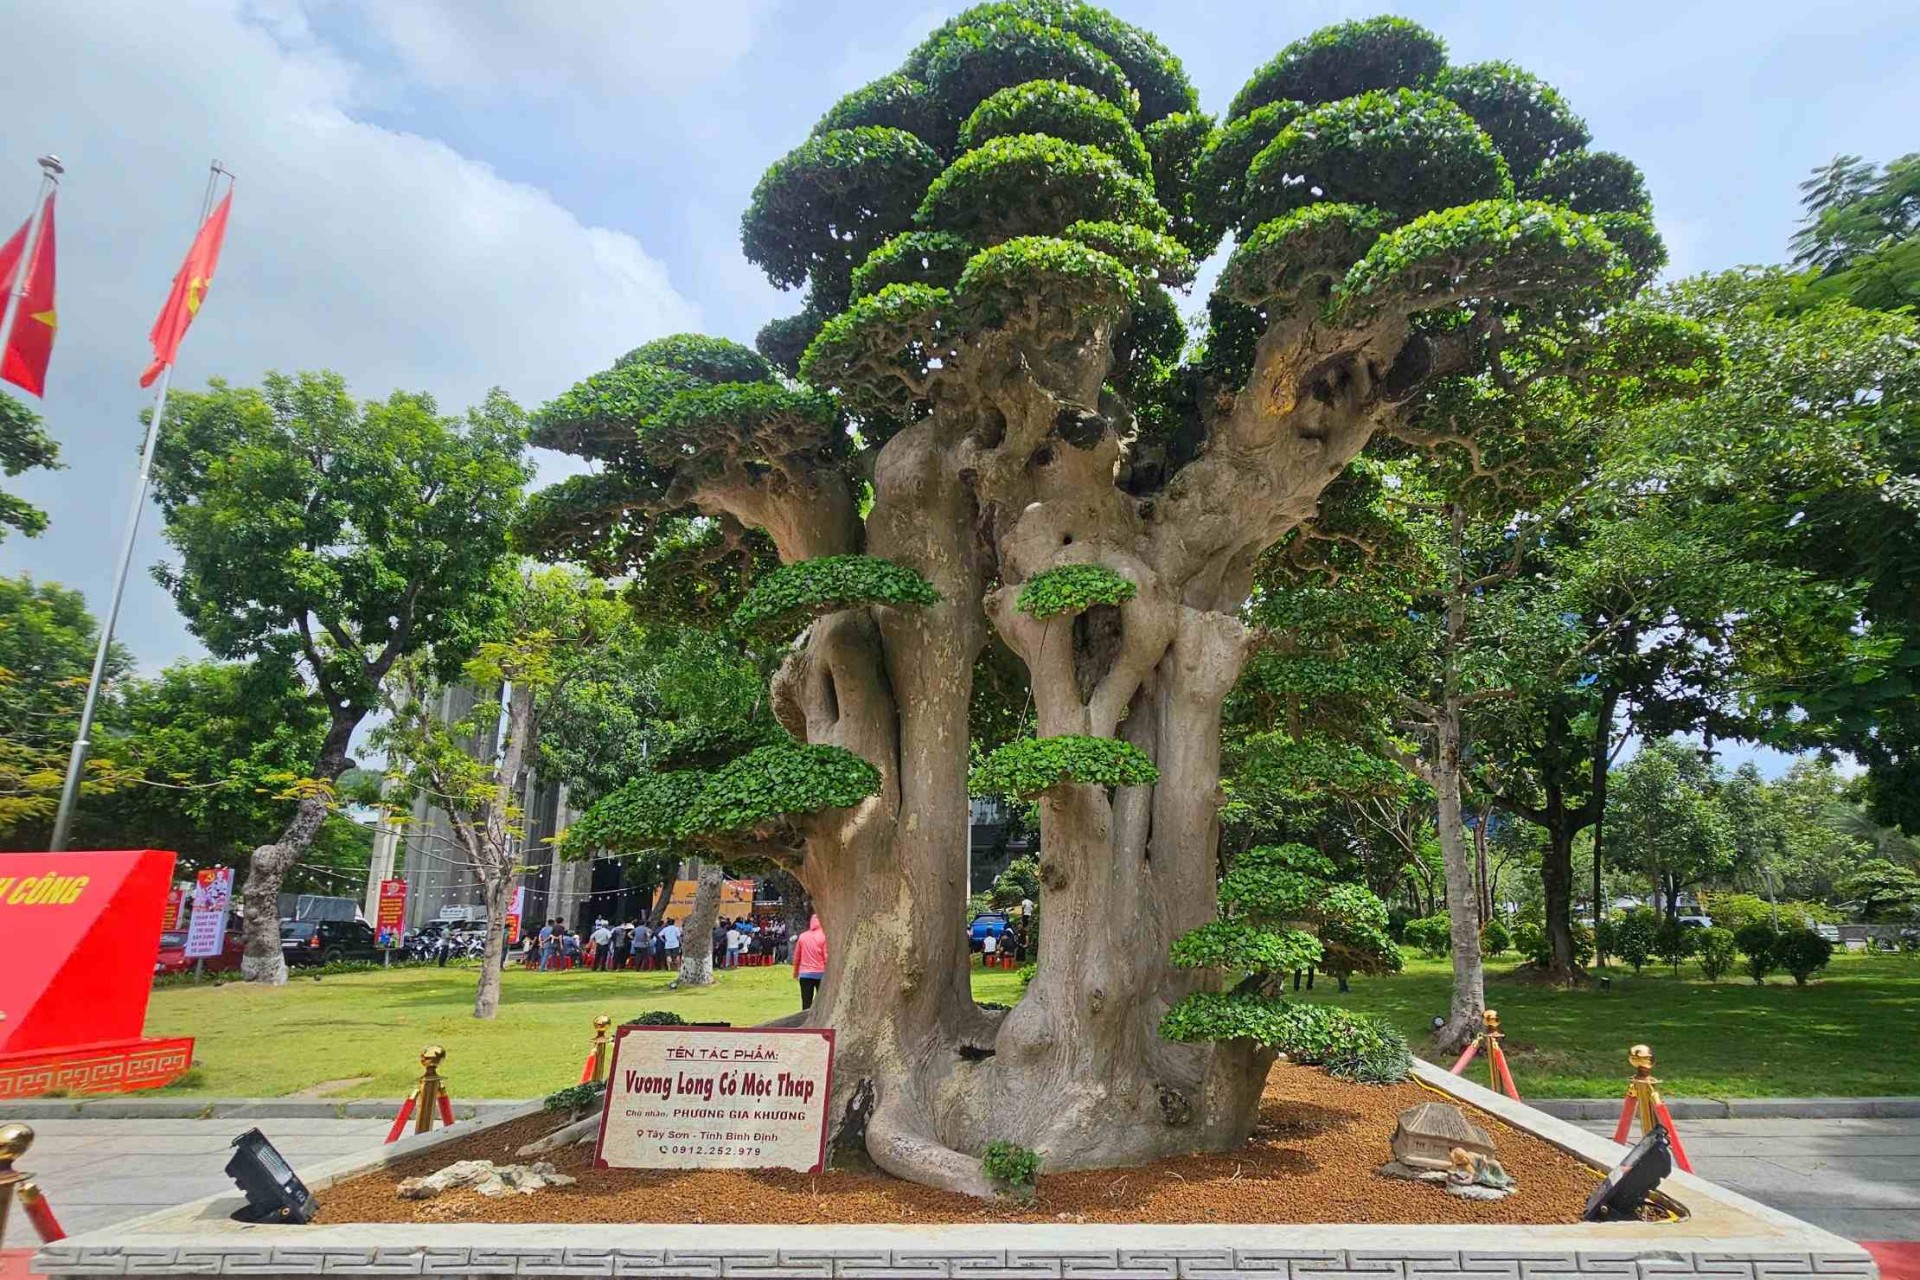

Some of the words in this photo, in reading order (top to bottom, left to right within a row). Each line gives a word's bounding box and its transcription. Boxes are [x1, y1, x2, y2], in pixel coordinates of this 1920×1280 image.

[7, 871, 90, 905] CÔNG
[667, 1046, 695, 1058] TÊN
[700, 1047, 729, 1059] TÁC
[735, 1045, 779, 1060] PHẨM:
[677, 1071, 714, 1101] Long
[719, 1069, 738, 1097] Cổ
[742, 1073, 772, 1103] Mộc
[778, 1073, 814, 1103] Tháp
[673, 1108, 724, 1119] PHƯƠNG
[729, 1109, 749, 1119] GIA
[754, 1109, 806, 1120] KHƯƠNG
[647, 1130, 664, 1139] Tây
[668, 1130, 689, 1139] Sơn
[726, 1131, 749, 1141] Bình
[753, 1132, 778, 1143] Định
[672, 1146, 761, 1156] 0912.252.979
